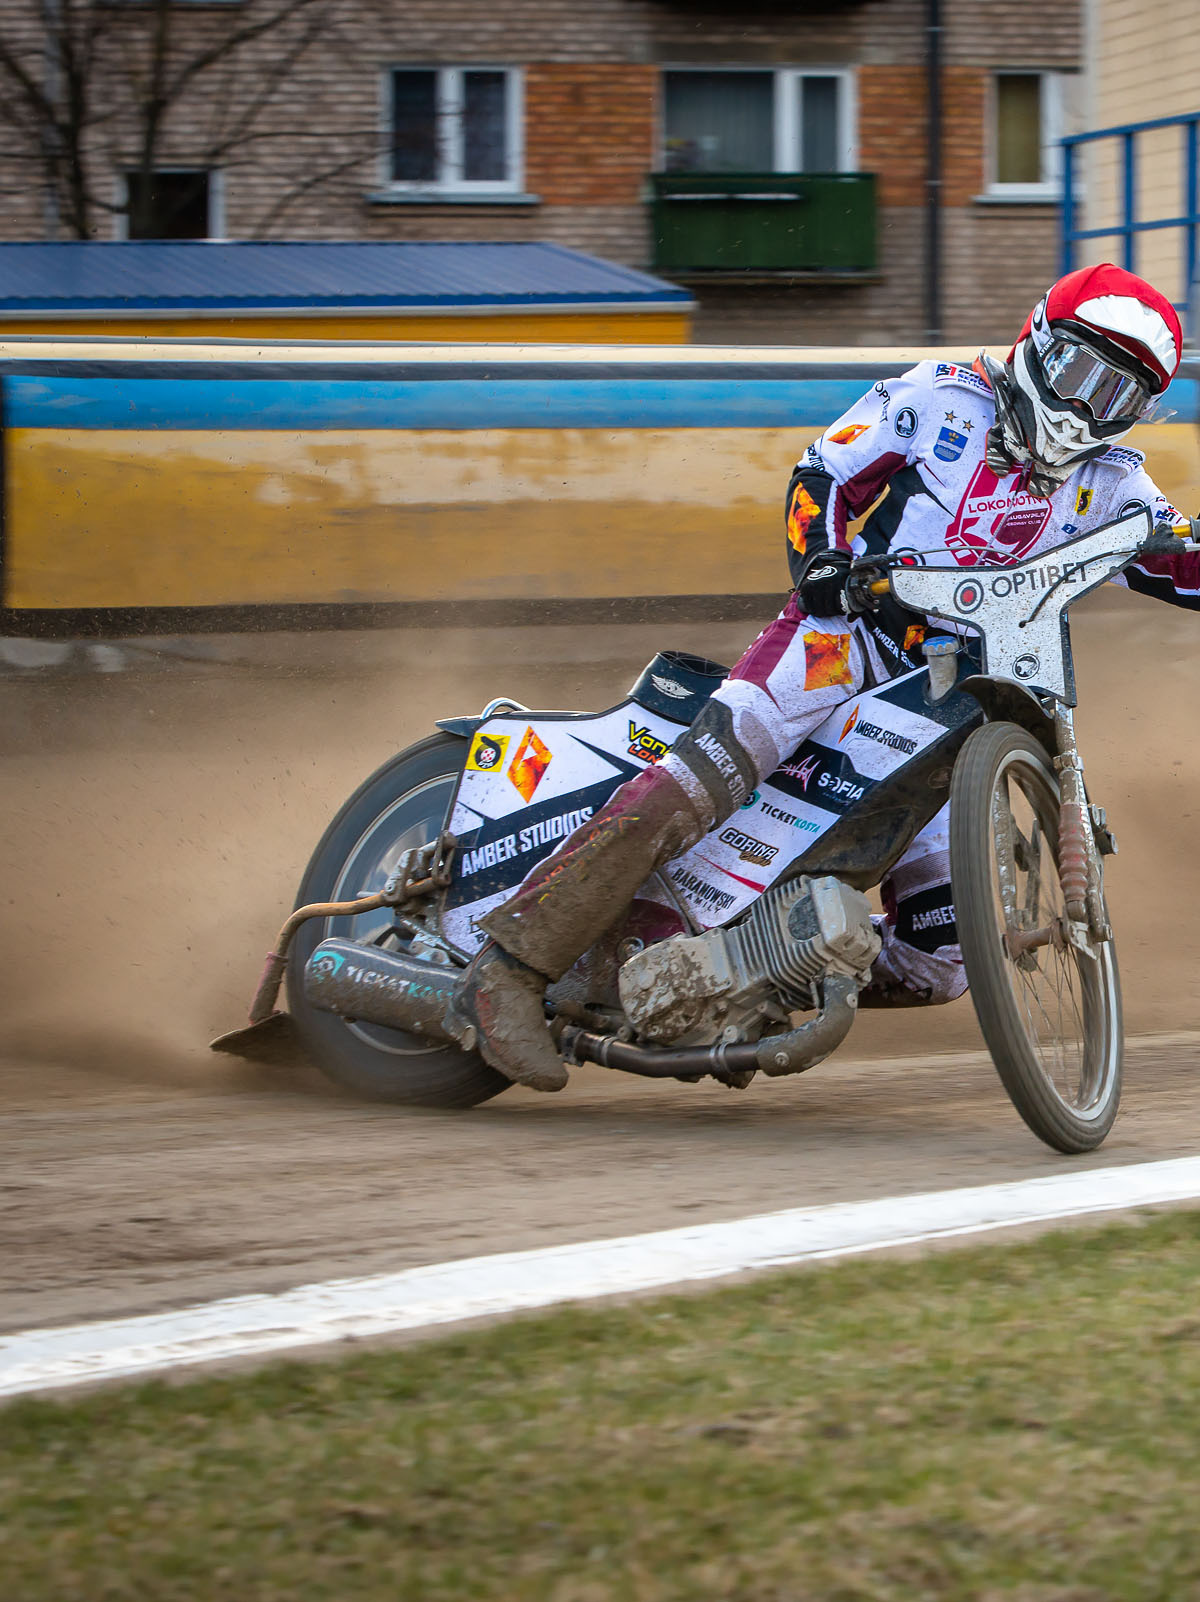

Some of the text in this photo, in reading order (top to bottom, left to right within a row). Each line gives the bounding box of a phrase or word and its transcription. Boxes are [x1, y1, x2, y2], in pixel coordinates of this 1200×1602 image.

[1007, 511, 1046, 521] AUGAVPILS
[991, 562, 1087, 598] OPTIBET
[854, 720, 917, 755] AMBER STUDIOS
[695, 733, 737, 779] AMBER
[461, 834, 518, 878] AMBER
[519, 806, 593, 852] STUDIOS
